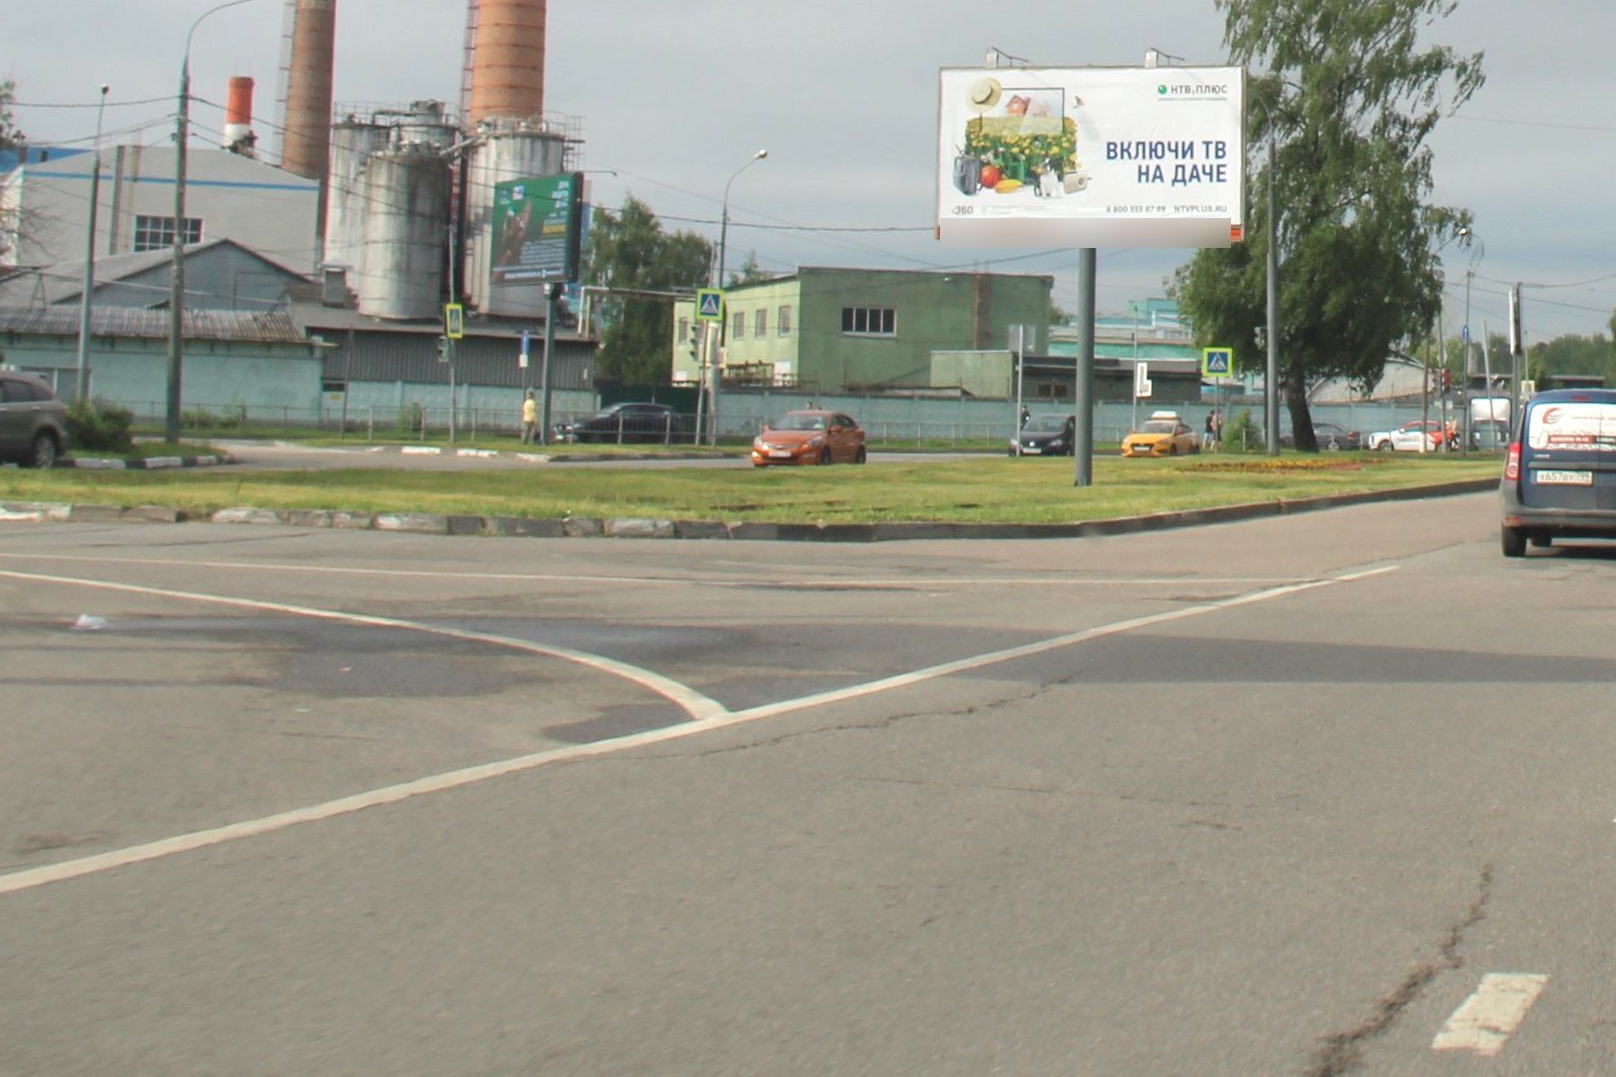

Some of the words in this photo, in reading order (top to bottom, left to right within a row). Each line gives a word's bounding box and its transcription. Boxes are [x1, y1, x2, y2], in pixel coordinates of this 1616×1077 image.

[1106, 141, 1194, 160] ВКЛЮЧИ
[1202, 140, 1226, 159] ТВ
[1137, 164, 1164, 183] НА
[1171, 164, 1227, 187] ДАЧЕ
